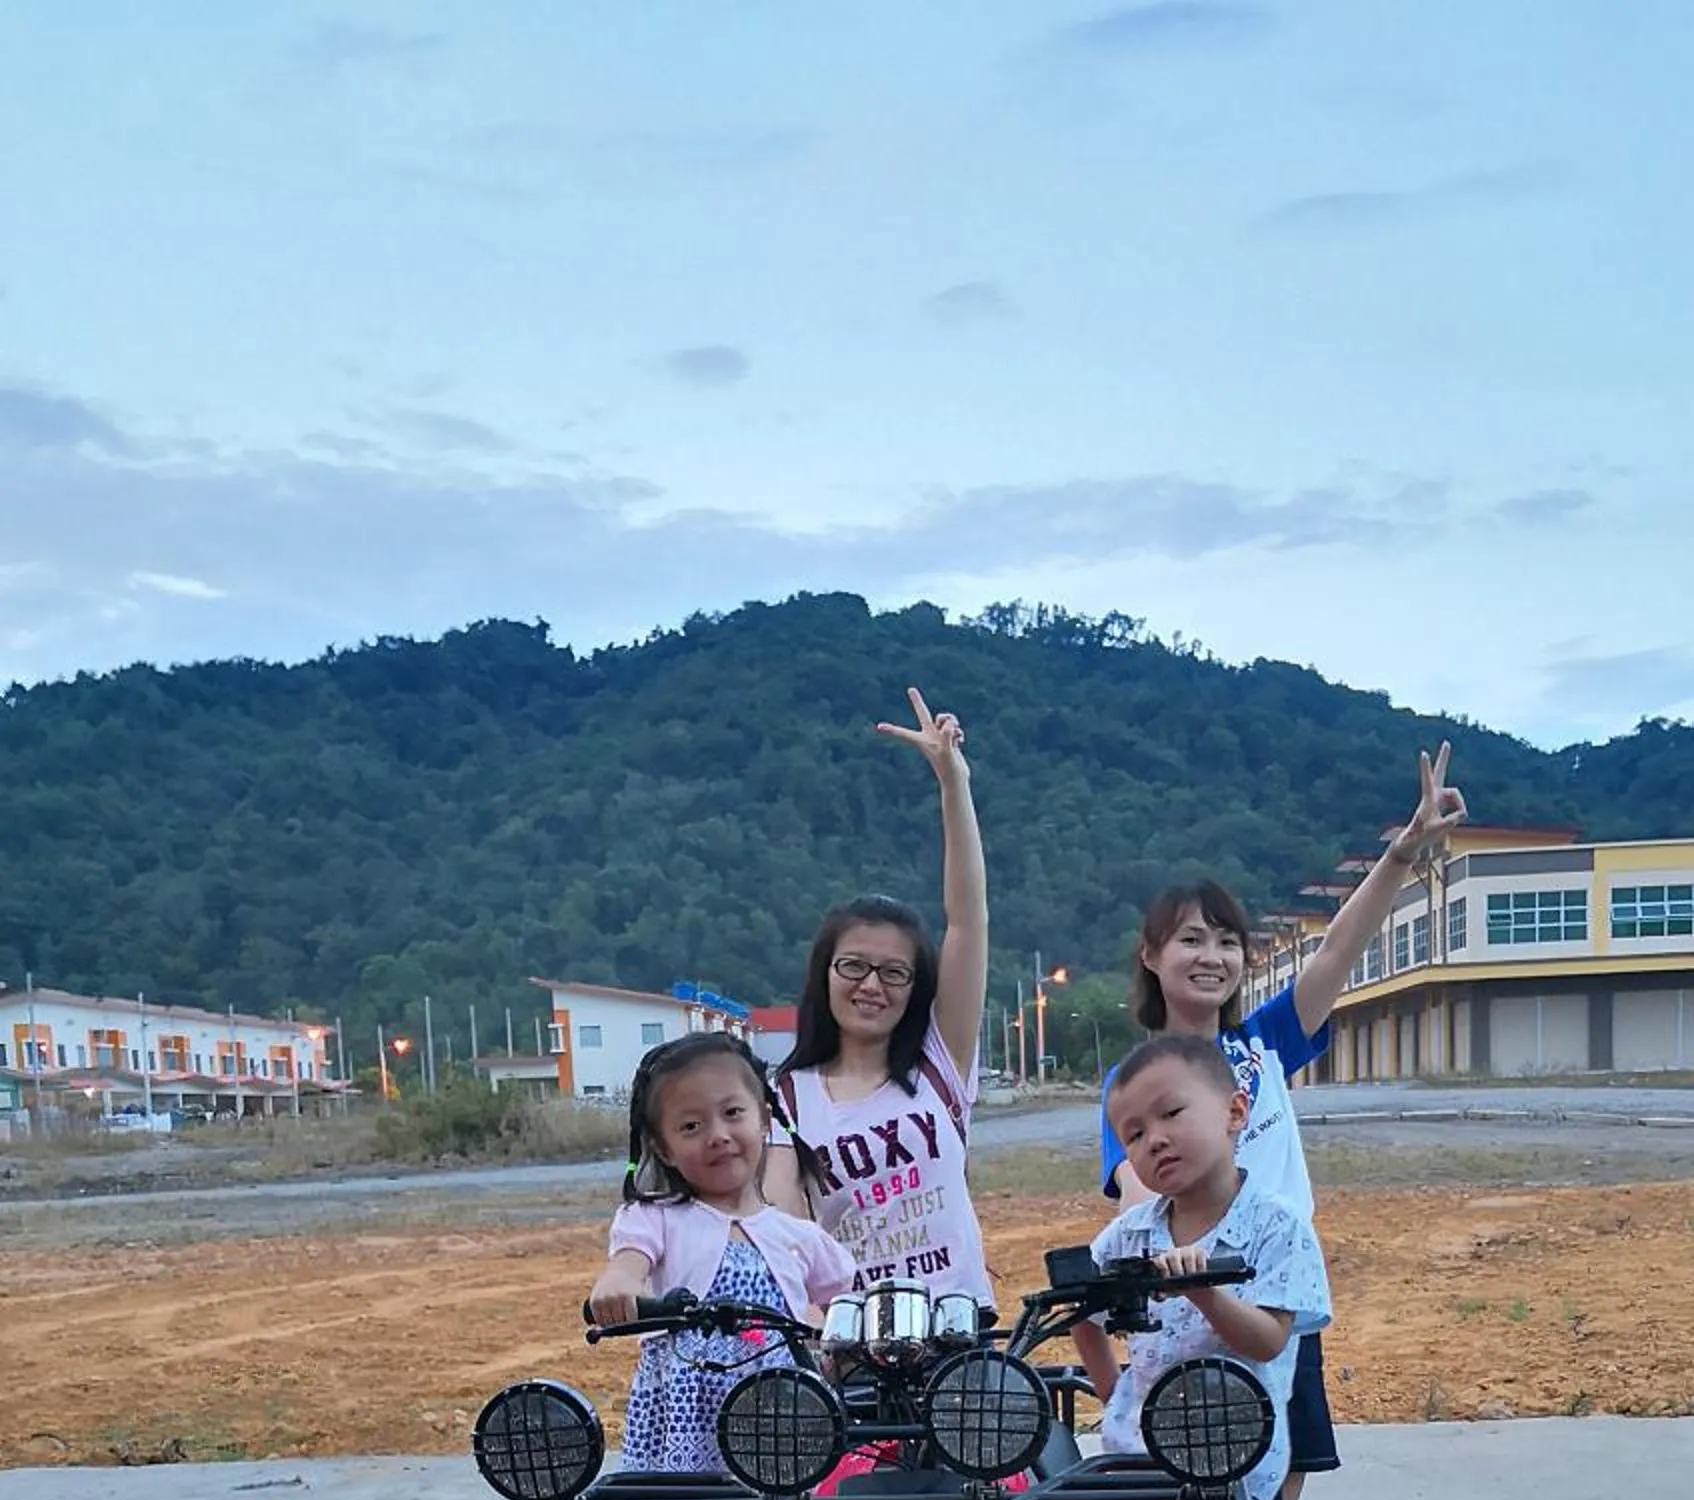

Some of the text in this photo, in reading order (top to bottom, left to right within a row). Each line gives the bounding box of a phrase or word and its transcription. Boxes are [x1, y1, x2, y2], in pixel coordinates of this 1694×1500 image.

[813, 1111, 940, 1197] ROXY
[898, 1186, 945, 1223] JUST
[851, 1224, 931, 1264] WANNA
[851, 1247, 951, 1292] AVE FUN
